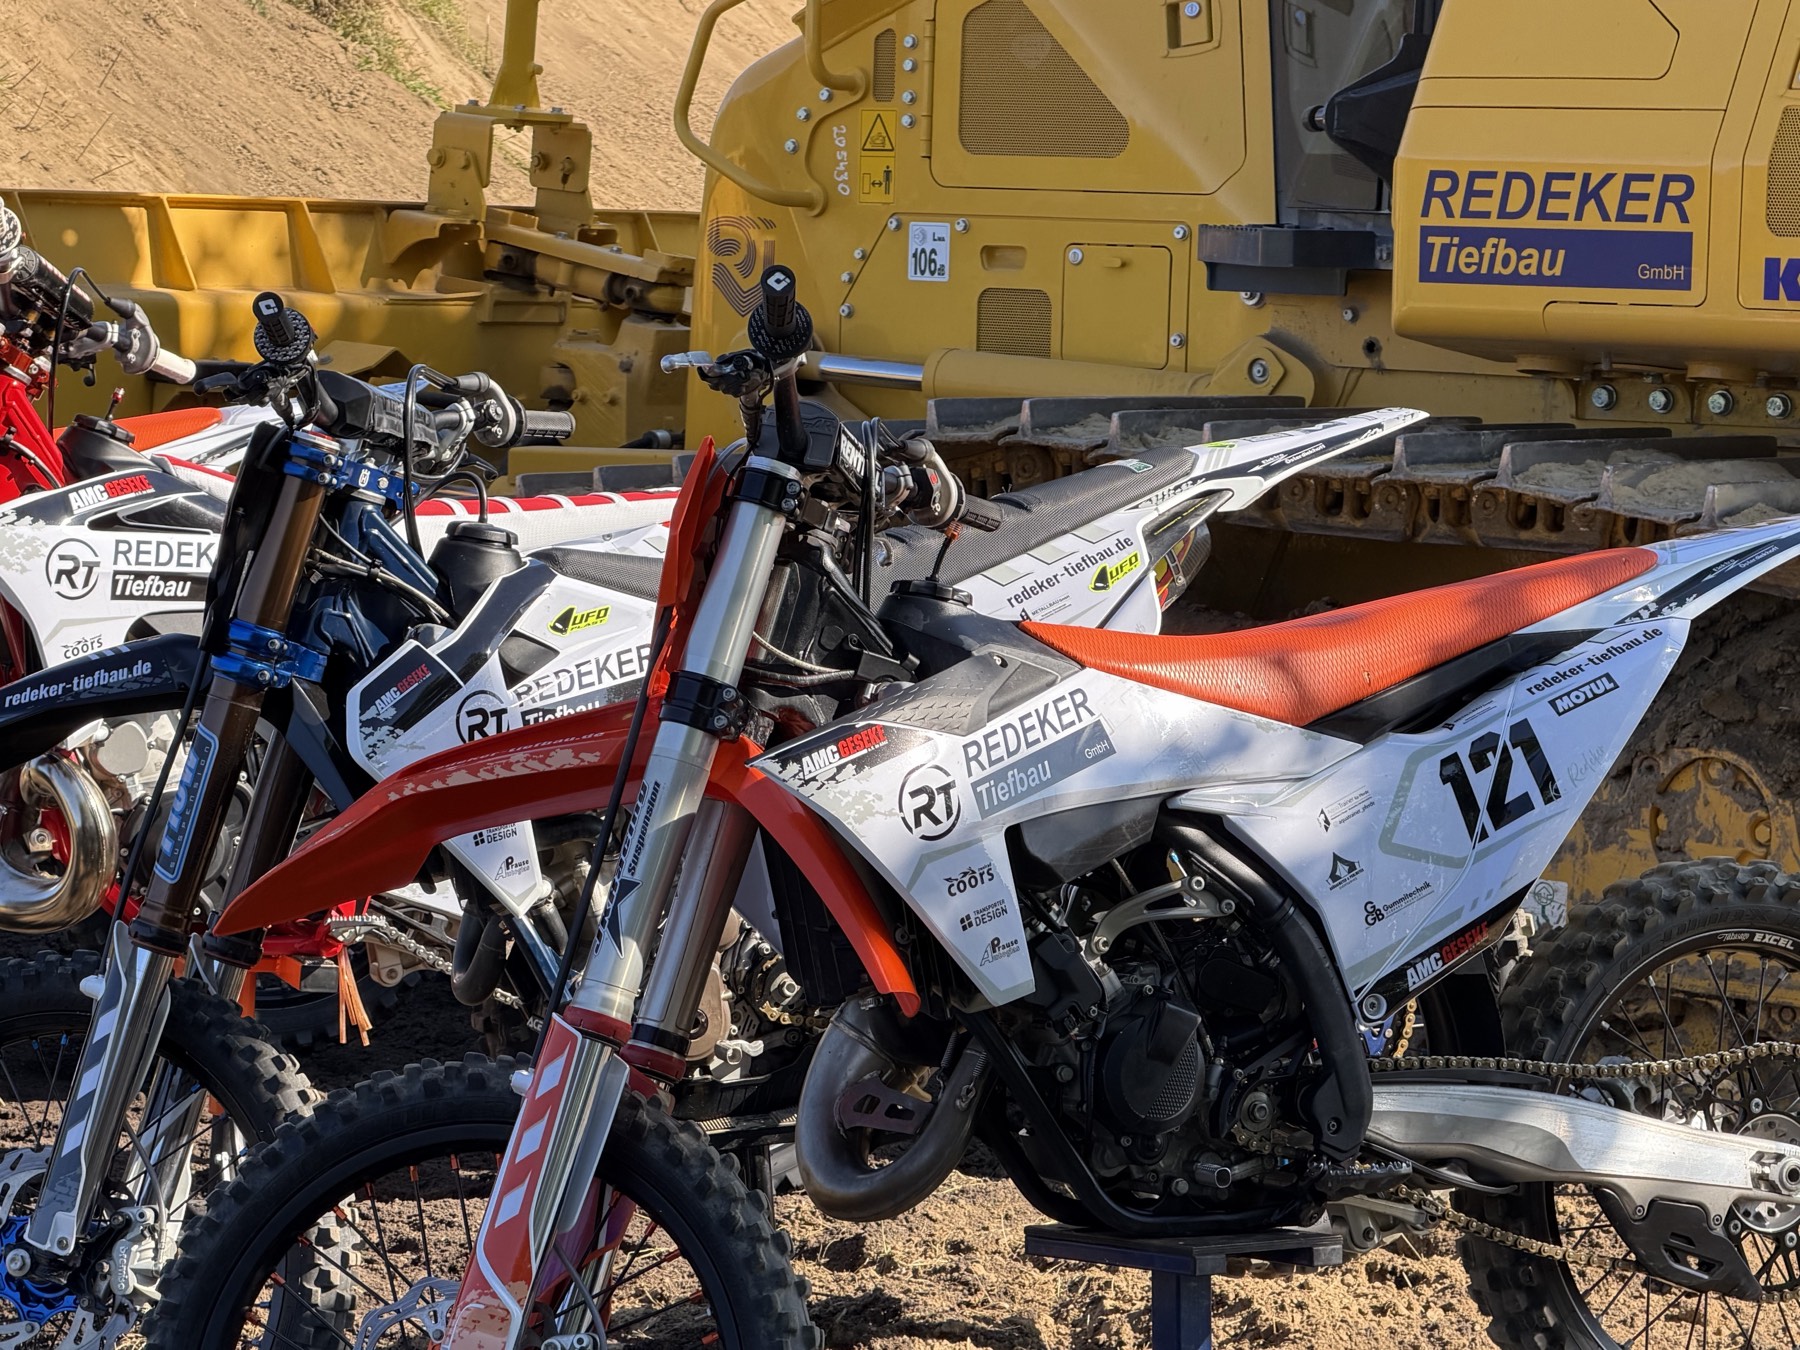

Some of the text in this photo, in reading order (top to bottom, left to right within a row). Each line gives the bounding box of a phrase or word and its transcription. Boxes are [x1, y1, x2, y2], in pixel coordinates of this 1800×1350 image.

[1420, 169, 1695, 224] REDEKER
[912, 247, 937, 276] 106
[1426, 235, 1685, 281] Tiefbau GmbH
[69, 474, 153, 510] AMC GESEKE
[115, 573, 192, 597] Tiefbau
[1006, 535, 1135, 608] redeker-tiefbau.de
[1109, 552, 1140, 584] UFO
[571, 606, 609, 628] UFO
[63, 636, 103, 660] coors
[1526, 625, 1664, 697] redeker-tiefbau.de
[4, 659, 153, 708] redeker-tiefbau.de
[374, 663, 431, 713] AMC GESEKE
[1556, 676, 1617, 714] MOTUL
[801, 724, 889, 777] AMC GESEKE
[963, 687, 1096, 778] REDEKER
[976, 739, 1111, 811] Tiefbau GmbH
[1438, 717, 1562, 848] 121
[486, 827, 518, 845] DESIGN
[627, 780, 661, 877] Suspension
[947, 869, 995, 898] coors
[1382, 881, 1433, 913] Gummitechnik
[973, 898, 1006, 917] TRANSPORTER
[974, 905, 1009, 928] DESIGN
[1406, 923, 1489, 988] AMC GESEKE
[1753, 932, 1795, 950] EXCEL
